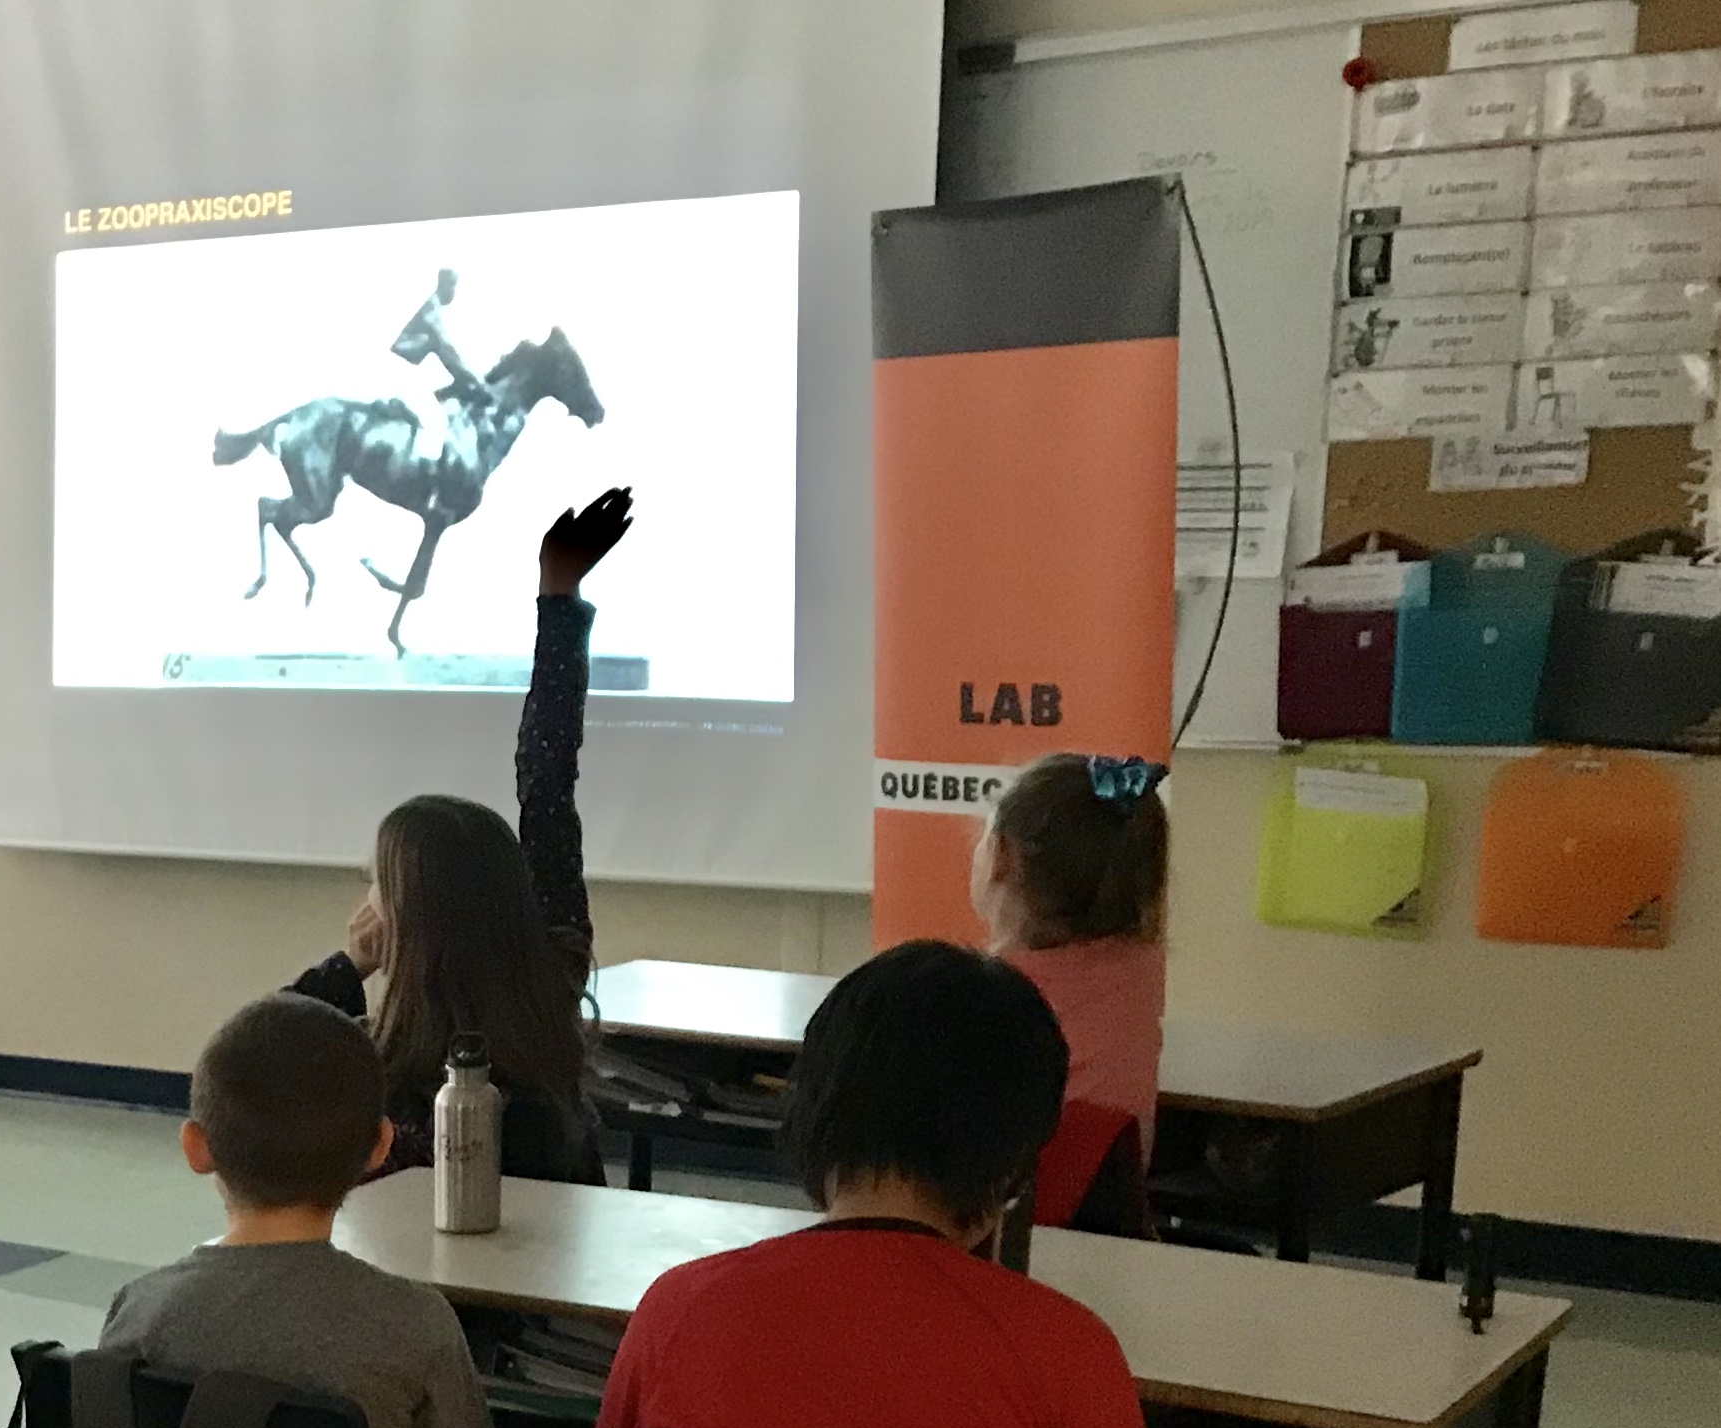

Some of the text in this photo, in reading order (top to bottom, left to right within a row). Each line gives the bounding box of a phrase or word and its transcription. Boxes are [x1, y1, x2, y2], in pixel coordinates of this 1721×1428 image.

[64, 190, 293, 233] LE ZOOPRAXISCOPE
[959, 682, 1063, 726] LAB
